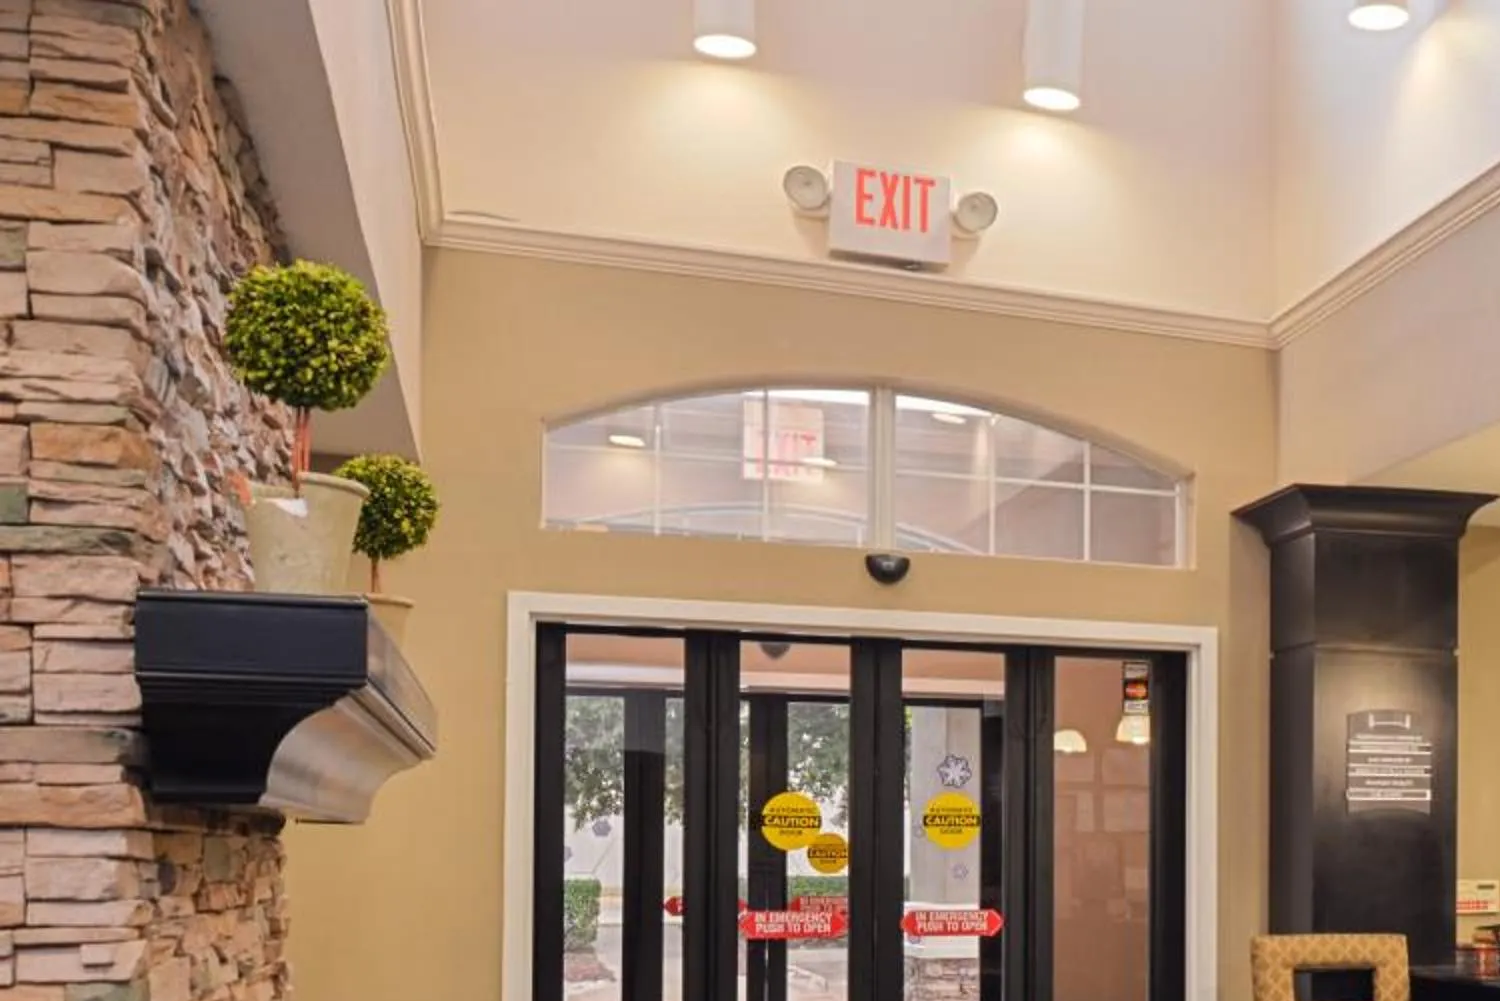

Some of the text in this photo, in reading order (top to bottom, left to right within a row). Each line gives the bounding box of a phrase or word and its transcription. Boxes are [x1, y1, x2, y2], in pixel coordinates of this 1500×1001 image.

[855, 167, 937, 233] EXIT
[764, 815, 819, 827] CAUTION
[925, 815, 978, 826] CAUTION
[755, 911, 832, 923] IN EMERGENCY
[916, 910, 988, 922] IN EMERGENCY
[755, 922, 832, 933] PUSH TO OPEN
[916, 921, 988, 933] PUSH TO OPEN
